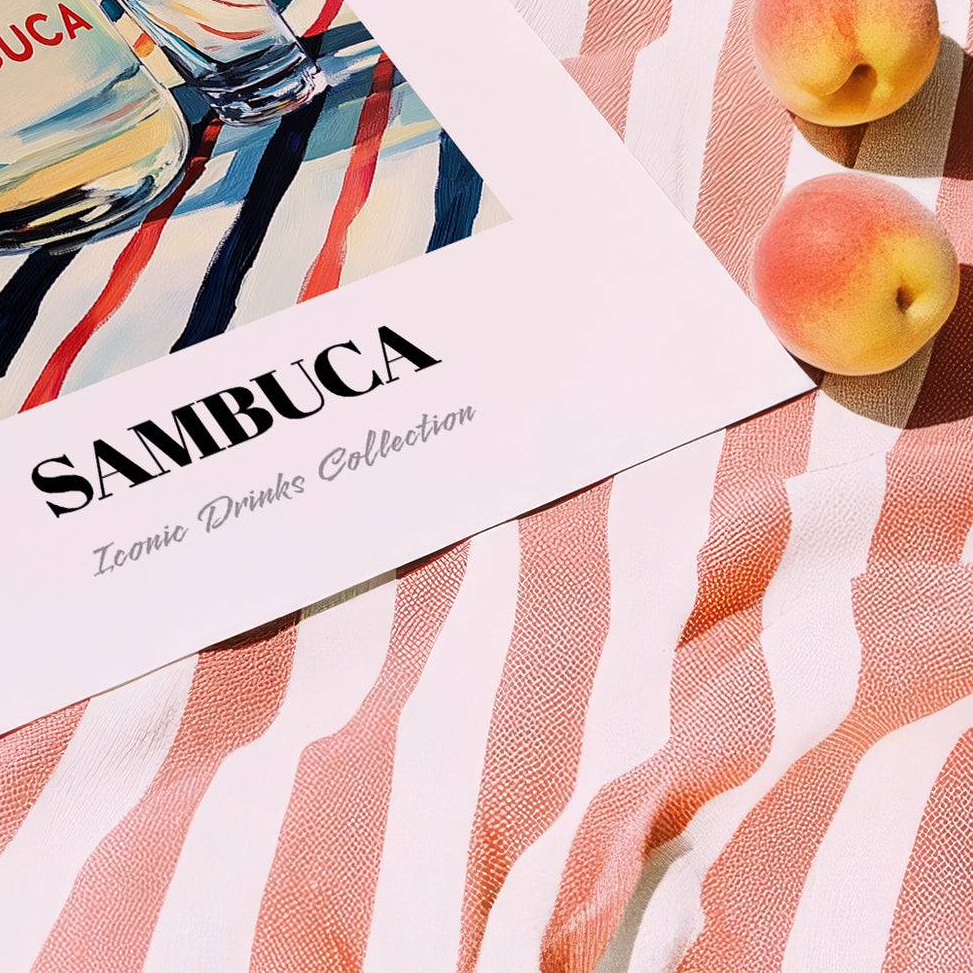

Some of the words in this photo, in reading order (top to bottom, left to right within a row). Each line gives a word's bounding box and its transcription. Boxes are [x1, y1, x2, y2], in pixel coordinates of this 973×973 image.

[31, 325, 442, 518] SAMBUCA
[92, 525, 189, 577] Iconic
[197, 472, 305, 533] Drinks
[318, 403, 477, 482] Collection
